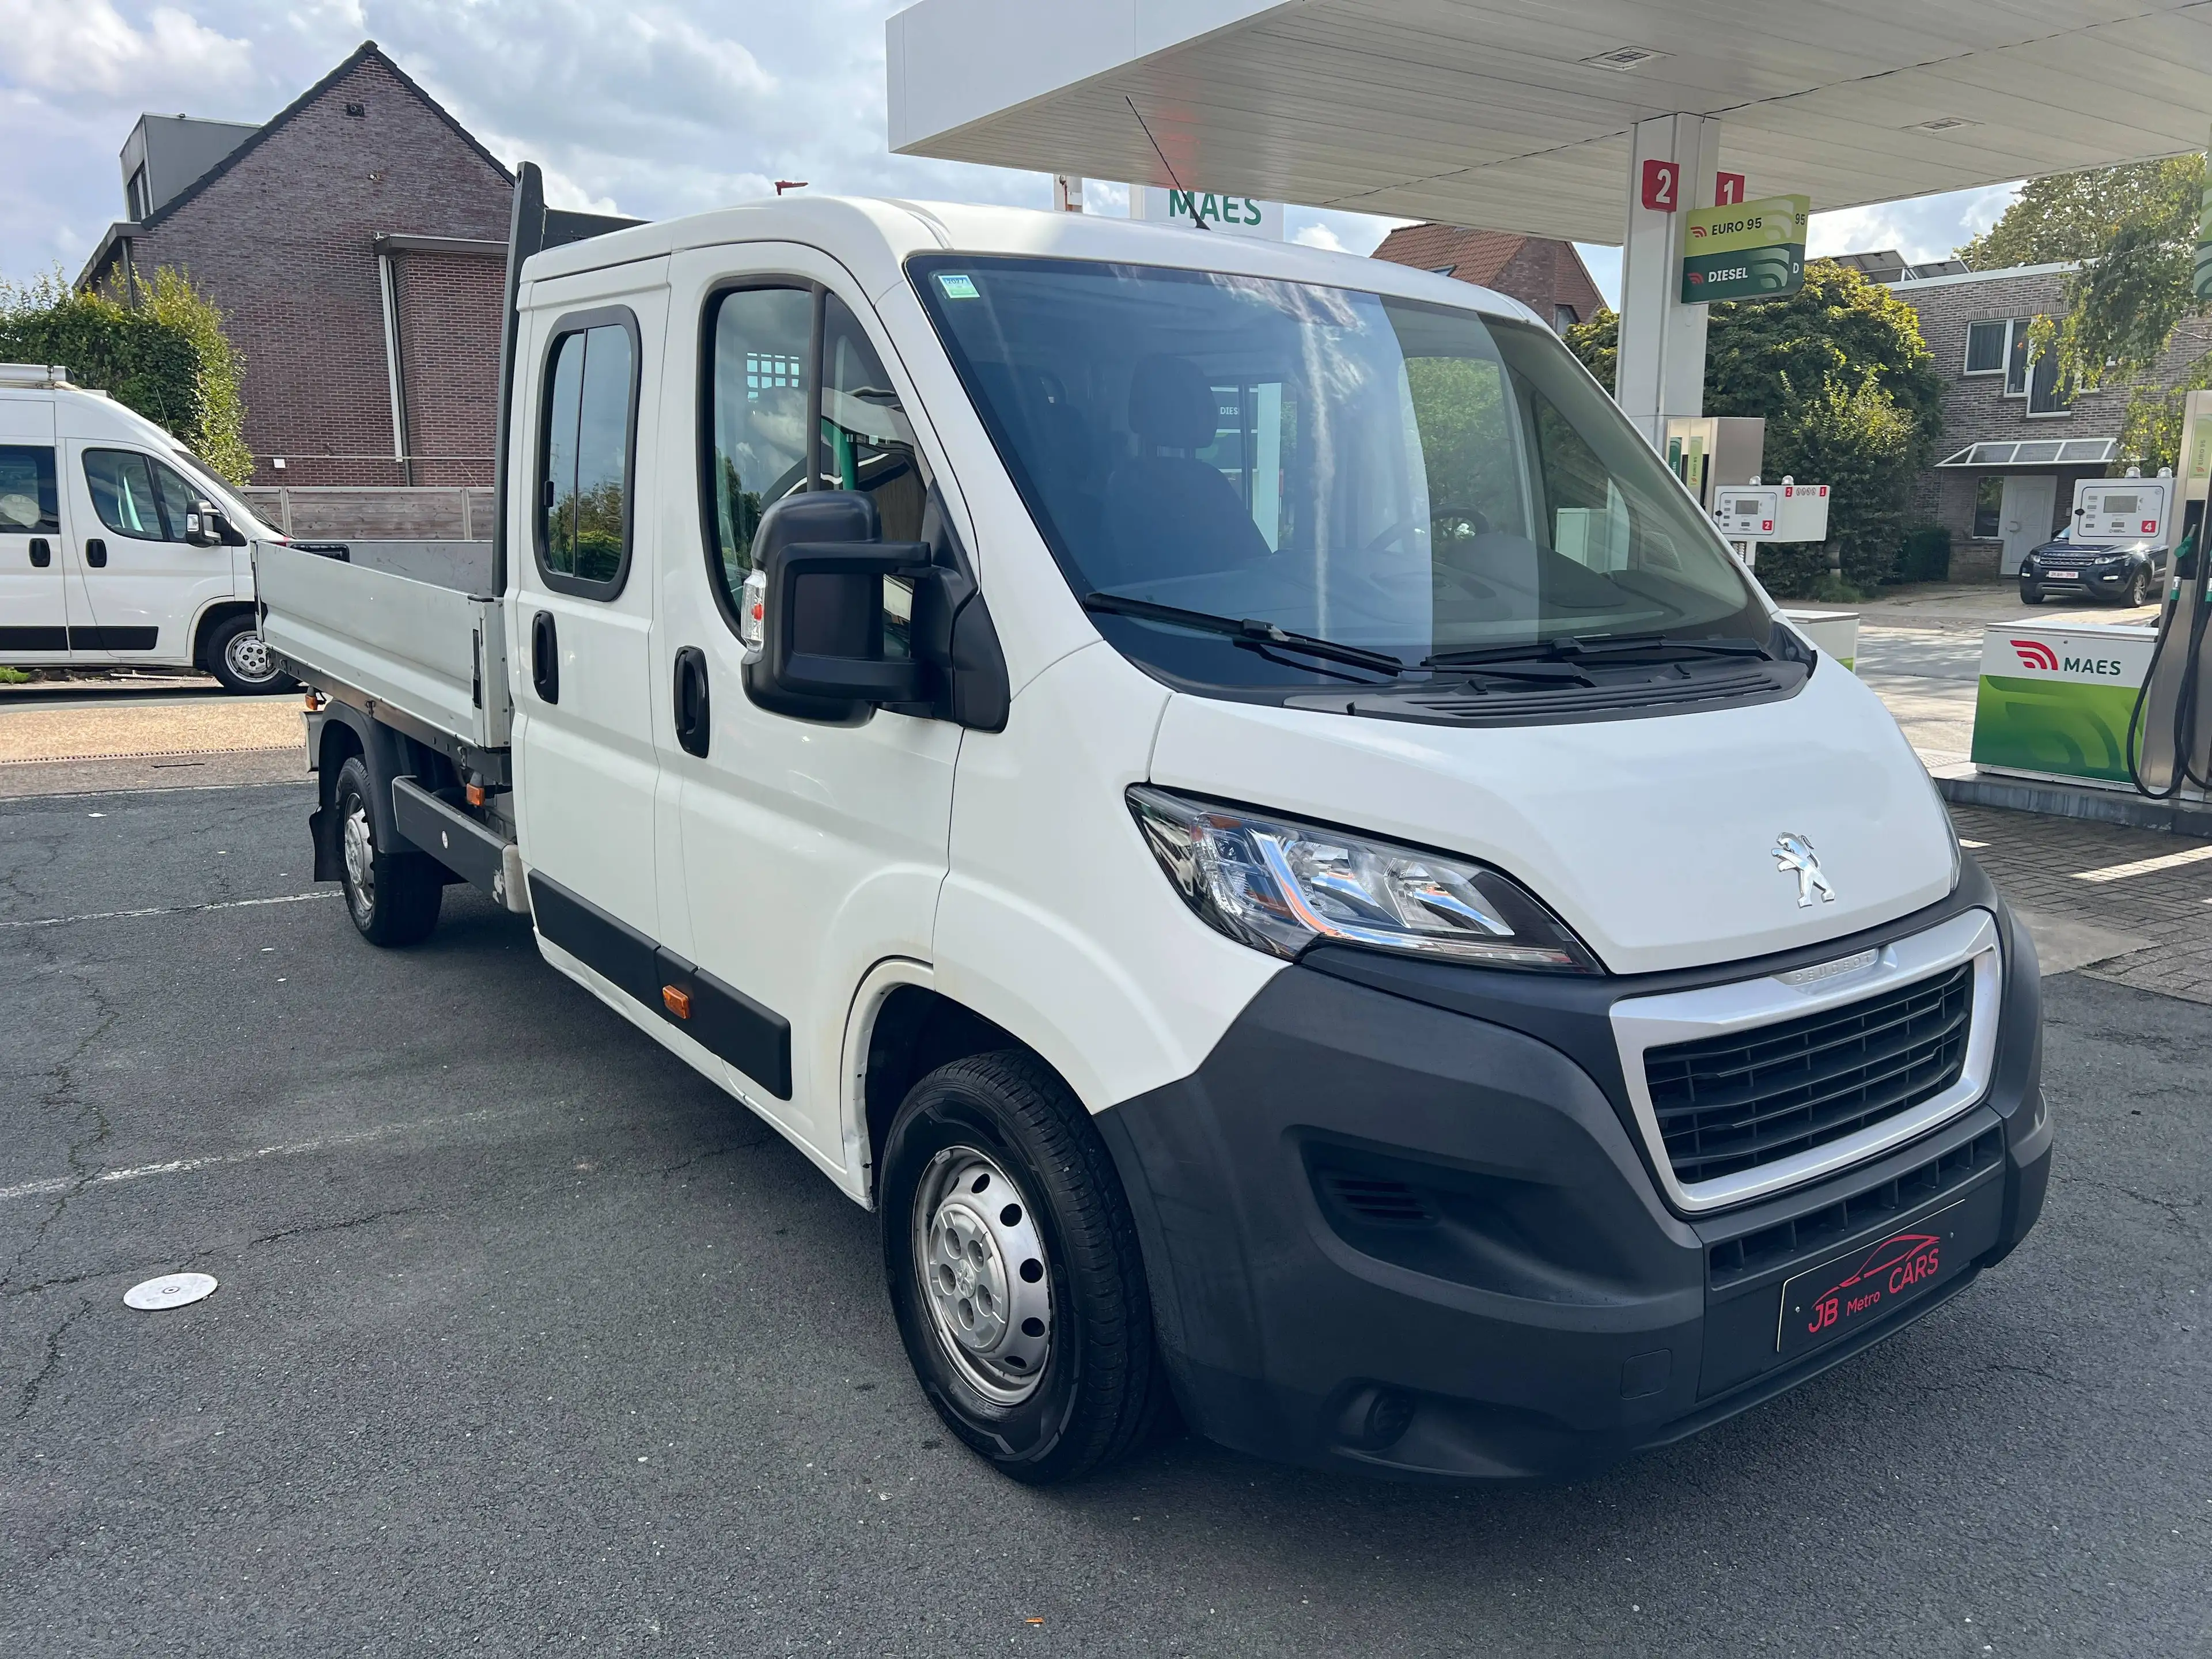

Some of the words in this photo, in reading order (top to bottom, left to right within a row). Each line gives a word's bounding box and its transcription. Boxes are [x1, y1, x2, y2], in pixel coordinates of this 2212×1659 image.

[1655, 168, 1671, 204] 2
[1723, 180, 1734, 205] 1
[1169, 189, 1262, 225] MAES
[1711, 221, 1744, 236] EURO
[1747, 217, 1762, 230] 95
[1794, 213, 1805, 225] 95
[1708, 267, 1748, 283] DIESEL
[1792, 262, 1800, 274] D
[1786, 488, 1791, 496] 2
[1820, 487, 1825, 496] 1
[1764, 521, 1771, 529] 2
[2144, 522, 2153, 531] 4
[2063, 657, 2122, 676] MAES
[1795, 953, 1872, 984] PEUGEOT
[1808, 1298, 1839, 1333] JB
[1846, 1291, 1881, 1316] Metro
[1888, 1248, 1940, 1294] CARS
